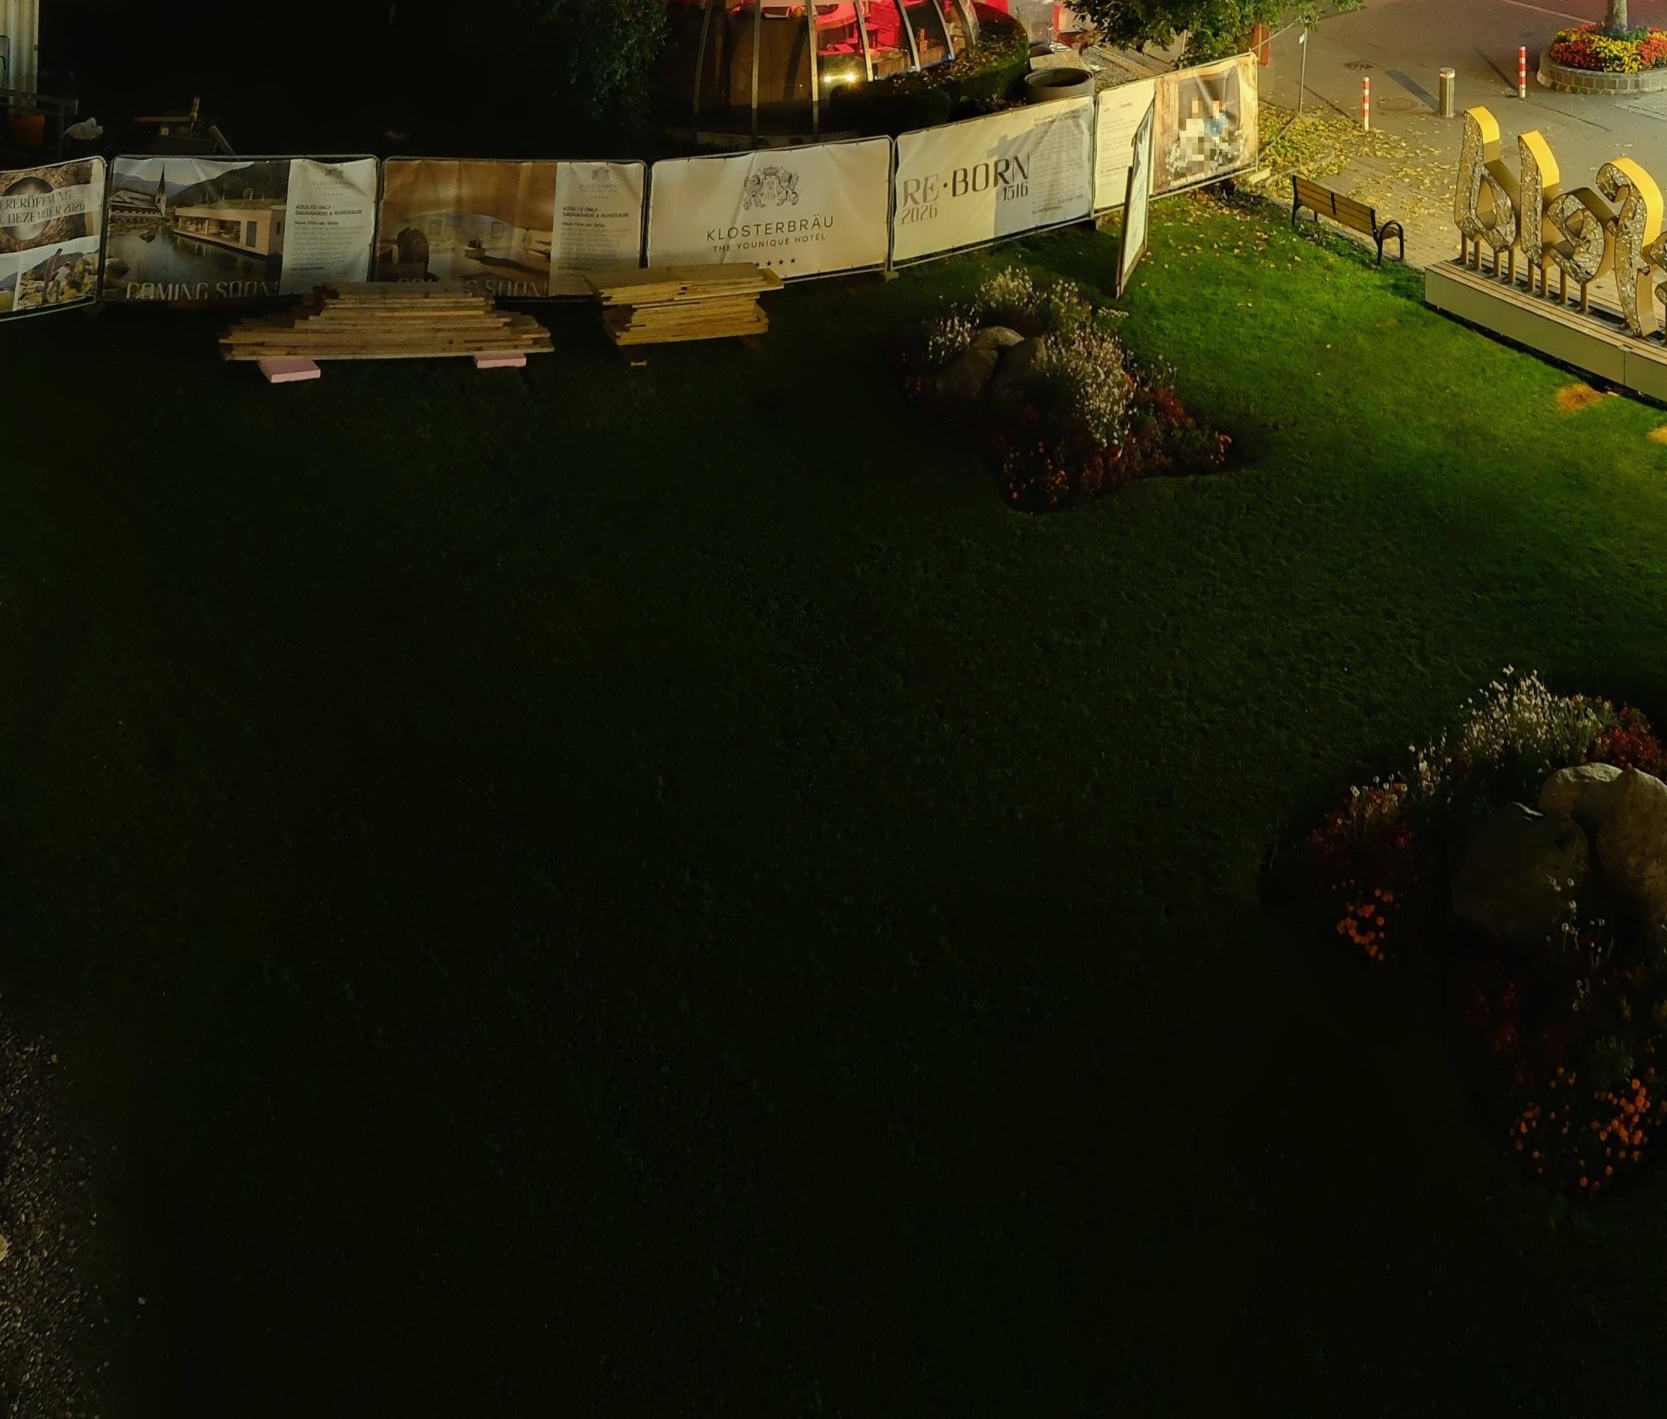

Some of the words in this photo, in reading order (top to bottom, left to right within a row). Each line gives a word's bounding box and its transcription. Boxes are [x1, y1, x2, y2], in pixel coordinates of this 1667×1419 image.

[1002, 182, 1029, 203] 1516
[901, 205, 939, 226] 2026
[706, 213, 835, 242] KLOSTERBRÄU
[712, 243, 731, 253] THE
[736, 237, 790, 251] YOUNIQUE
[794, 233, 827, 244] HOTEL
